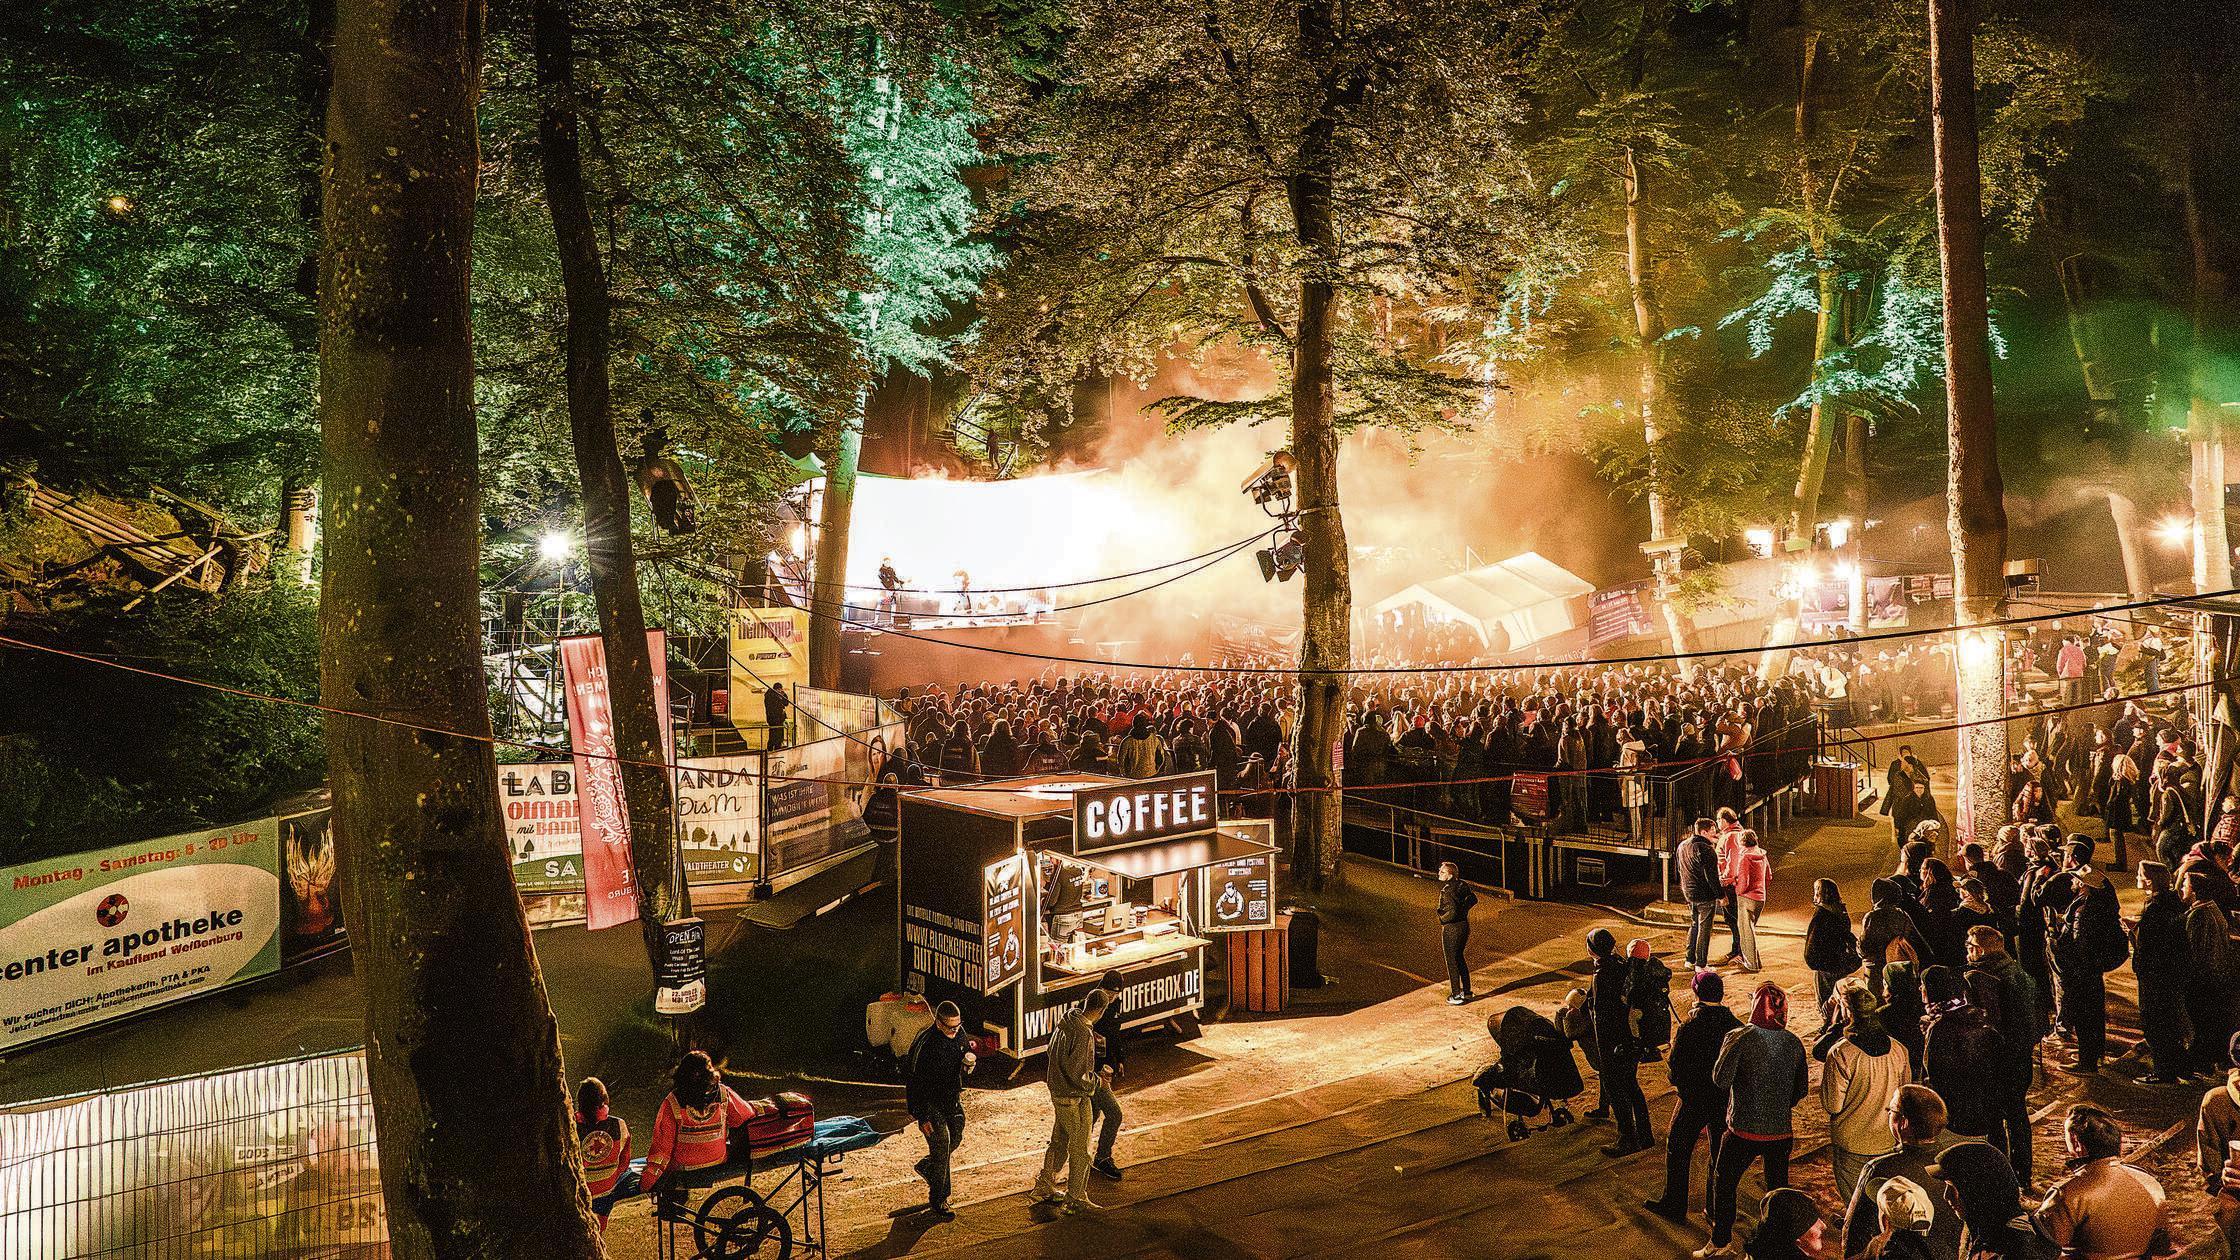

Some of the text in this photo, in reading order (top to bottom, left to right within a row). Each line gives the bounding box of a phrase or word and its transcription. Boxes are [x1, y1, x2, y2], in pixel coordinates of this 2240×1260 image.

[1086, 786, 1207, 838] COFFEE
[13, 867, 83, 889] Montag
[87, 930, 243, 976] im Kaufland Weißenburg
[103, 909, 243, 957] apotheke
[669, 931, 690, 944] OPEN
[906, 922, 983, 966] WWW.BLACKCOFFEE
[913, 944, 932, 975] BUT
[934, 951, 961, 985] FIRST
[3, 1016, 22, 1027] Wir
[24, 1005, 62, 1021] suchen
[161, 973, 180, 986] PTA
[191, 965, 211, 976] PKA
